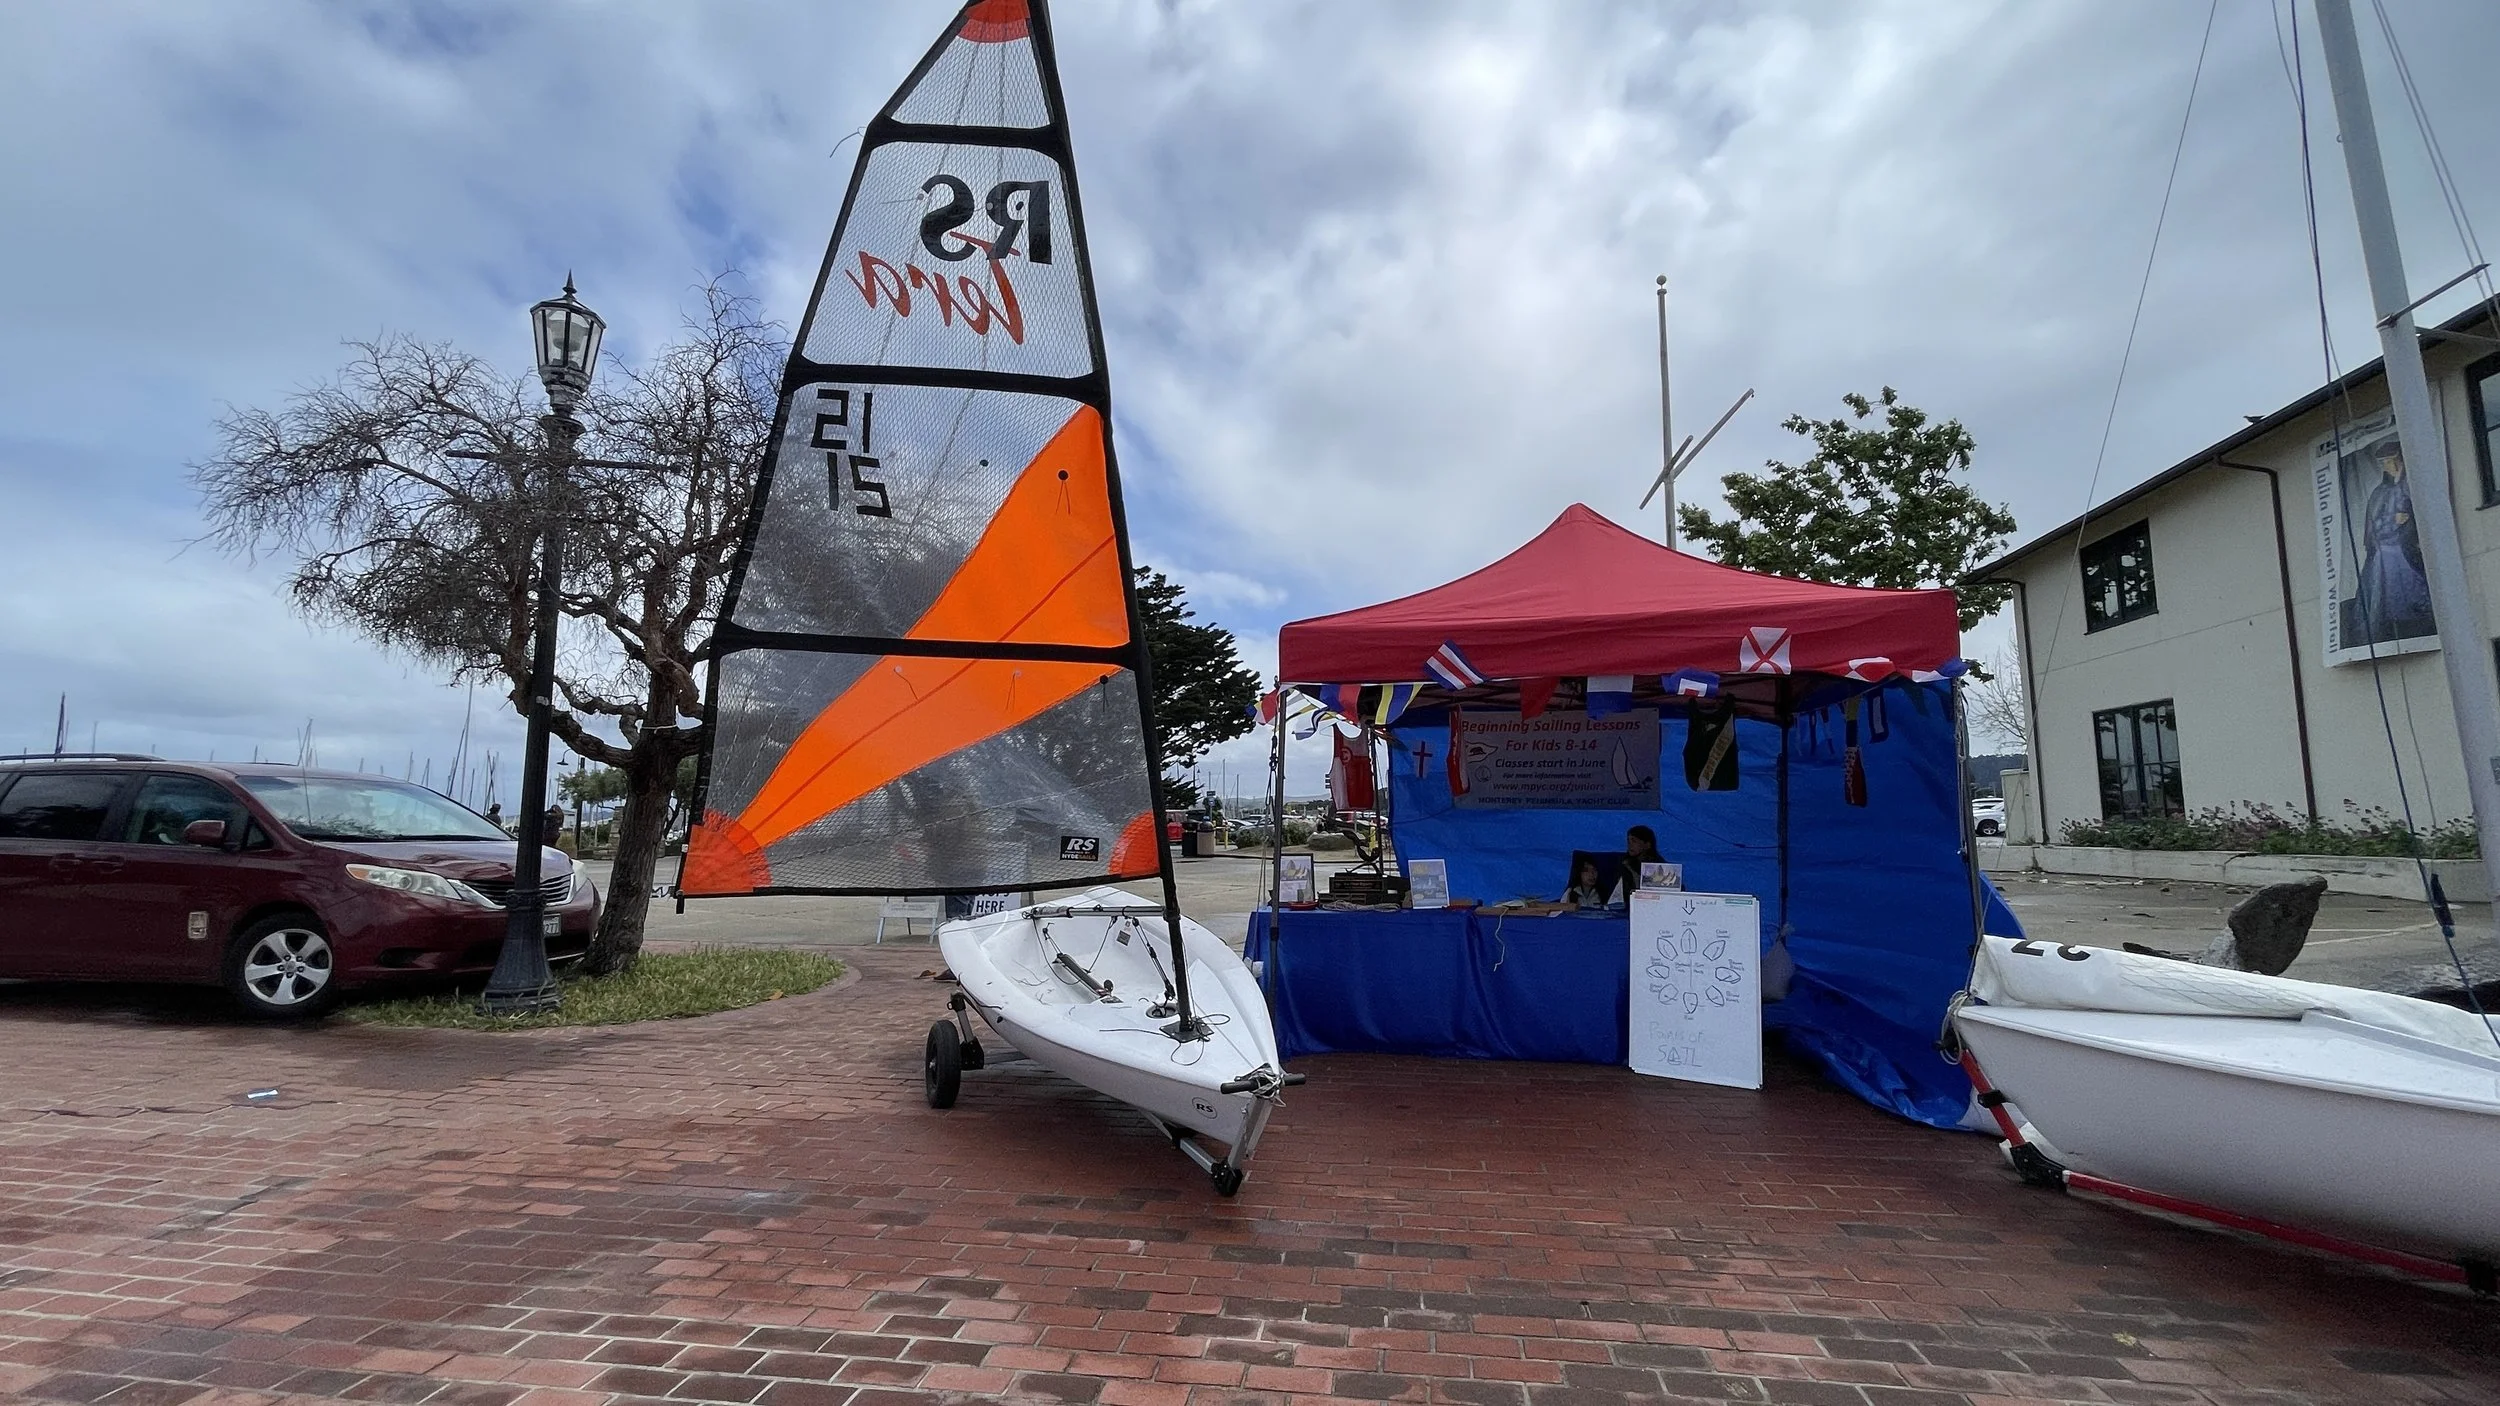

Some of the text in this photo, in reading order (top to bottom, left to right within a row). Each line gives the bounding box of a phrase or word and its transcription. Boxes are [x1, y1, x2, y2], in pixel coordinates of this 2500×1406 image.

[1462, 720, 1640, 734] Beginning Sailing Lessons
[1506, 739, 1597, 751] For Kids 8-14
[1495, 758, 1606, 768] Classes start in June
[1066, 838, 1096, 851] RS
[976, 900, 1005, 913] HERE
[1196, 1103, 1213, 1113] RS
